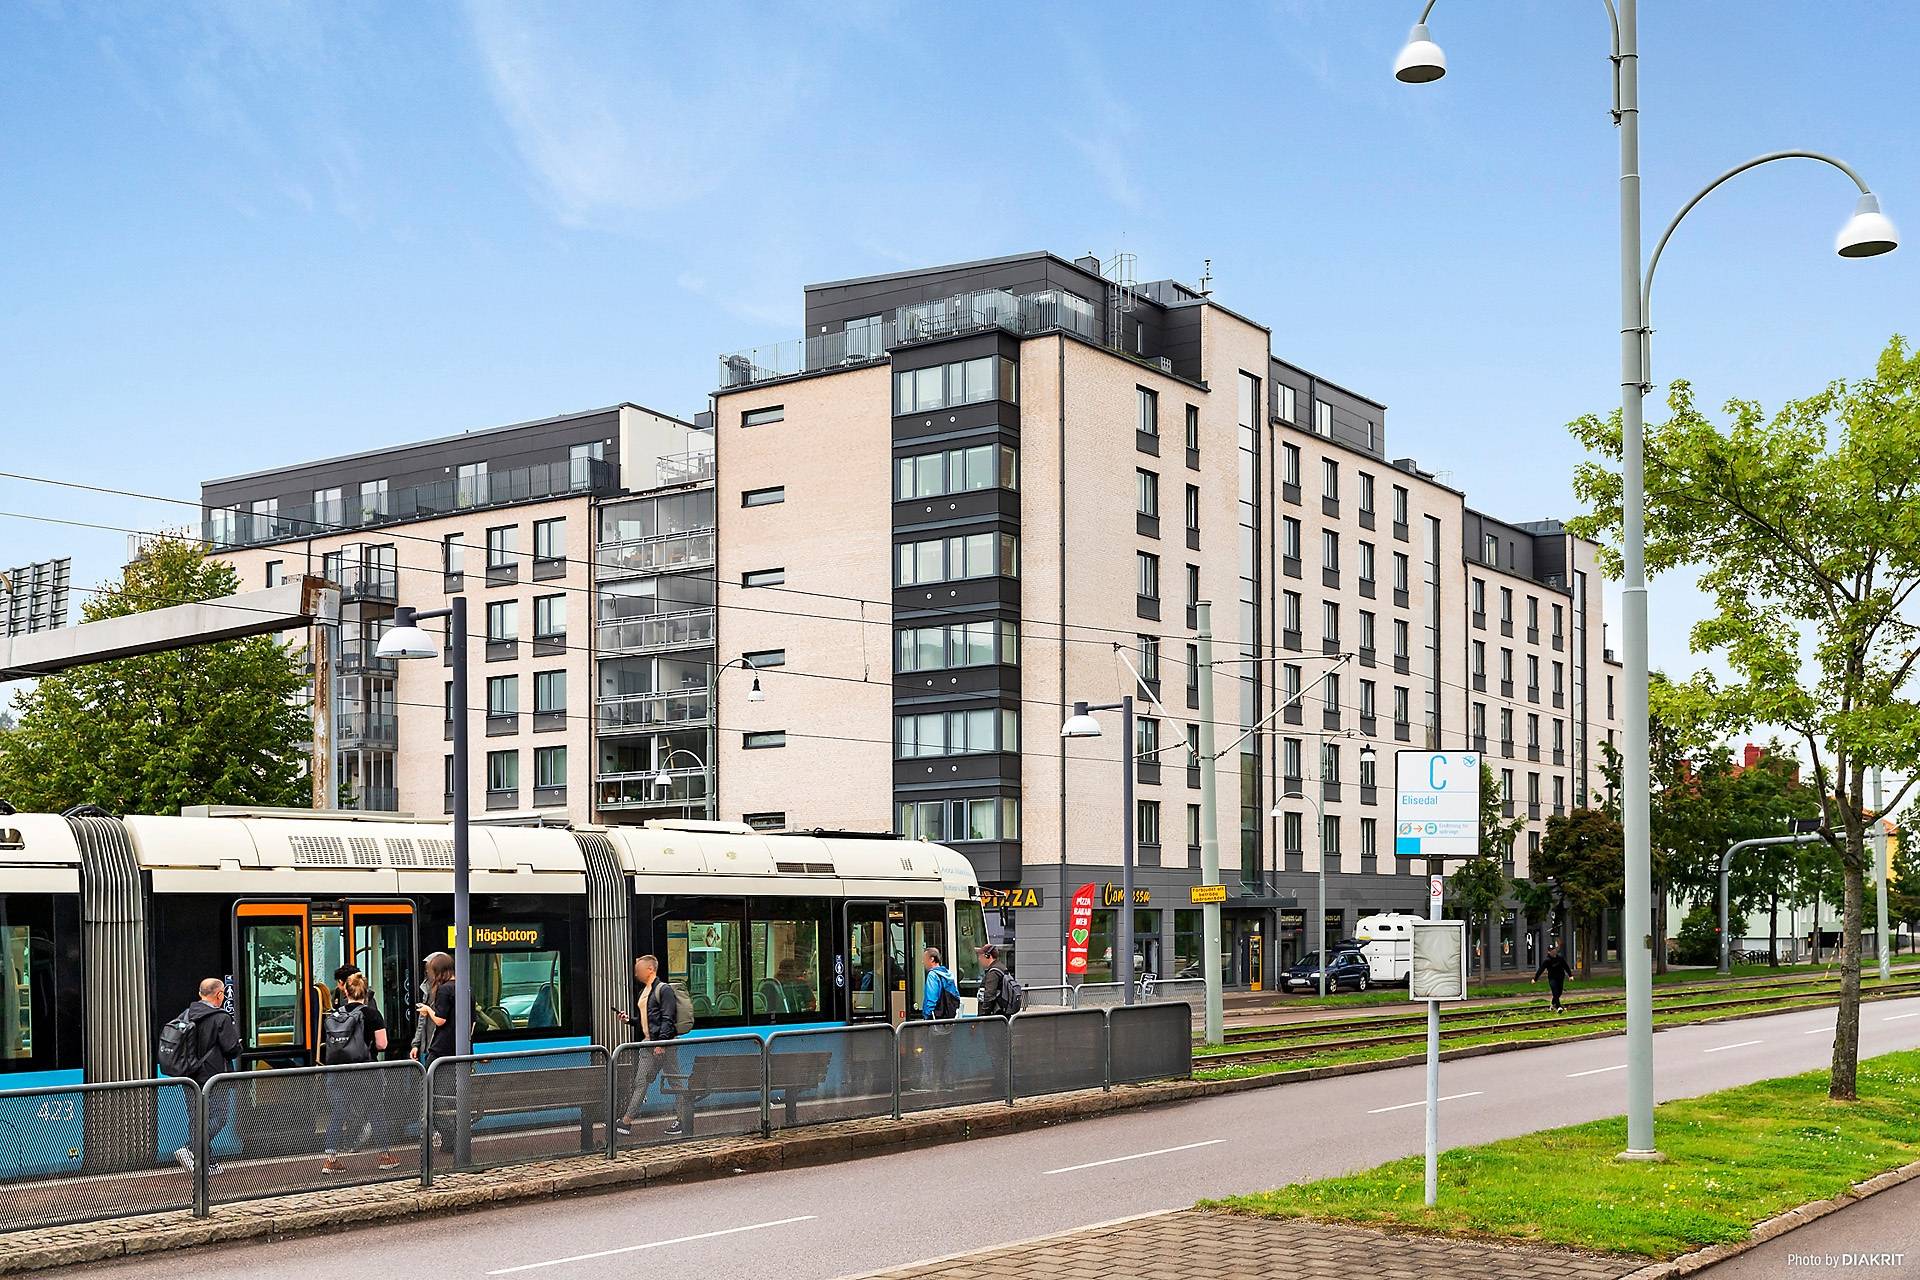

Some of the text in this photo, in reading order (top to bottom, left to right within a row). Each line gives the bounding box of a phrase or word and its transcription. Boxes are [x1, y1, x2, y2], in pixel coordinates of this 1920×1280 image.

[1429, 755, 1447, 790] C
[1402, 795, 1438, 805] Elisedal
[476, 926, 538, 944] Högsbotorp
